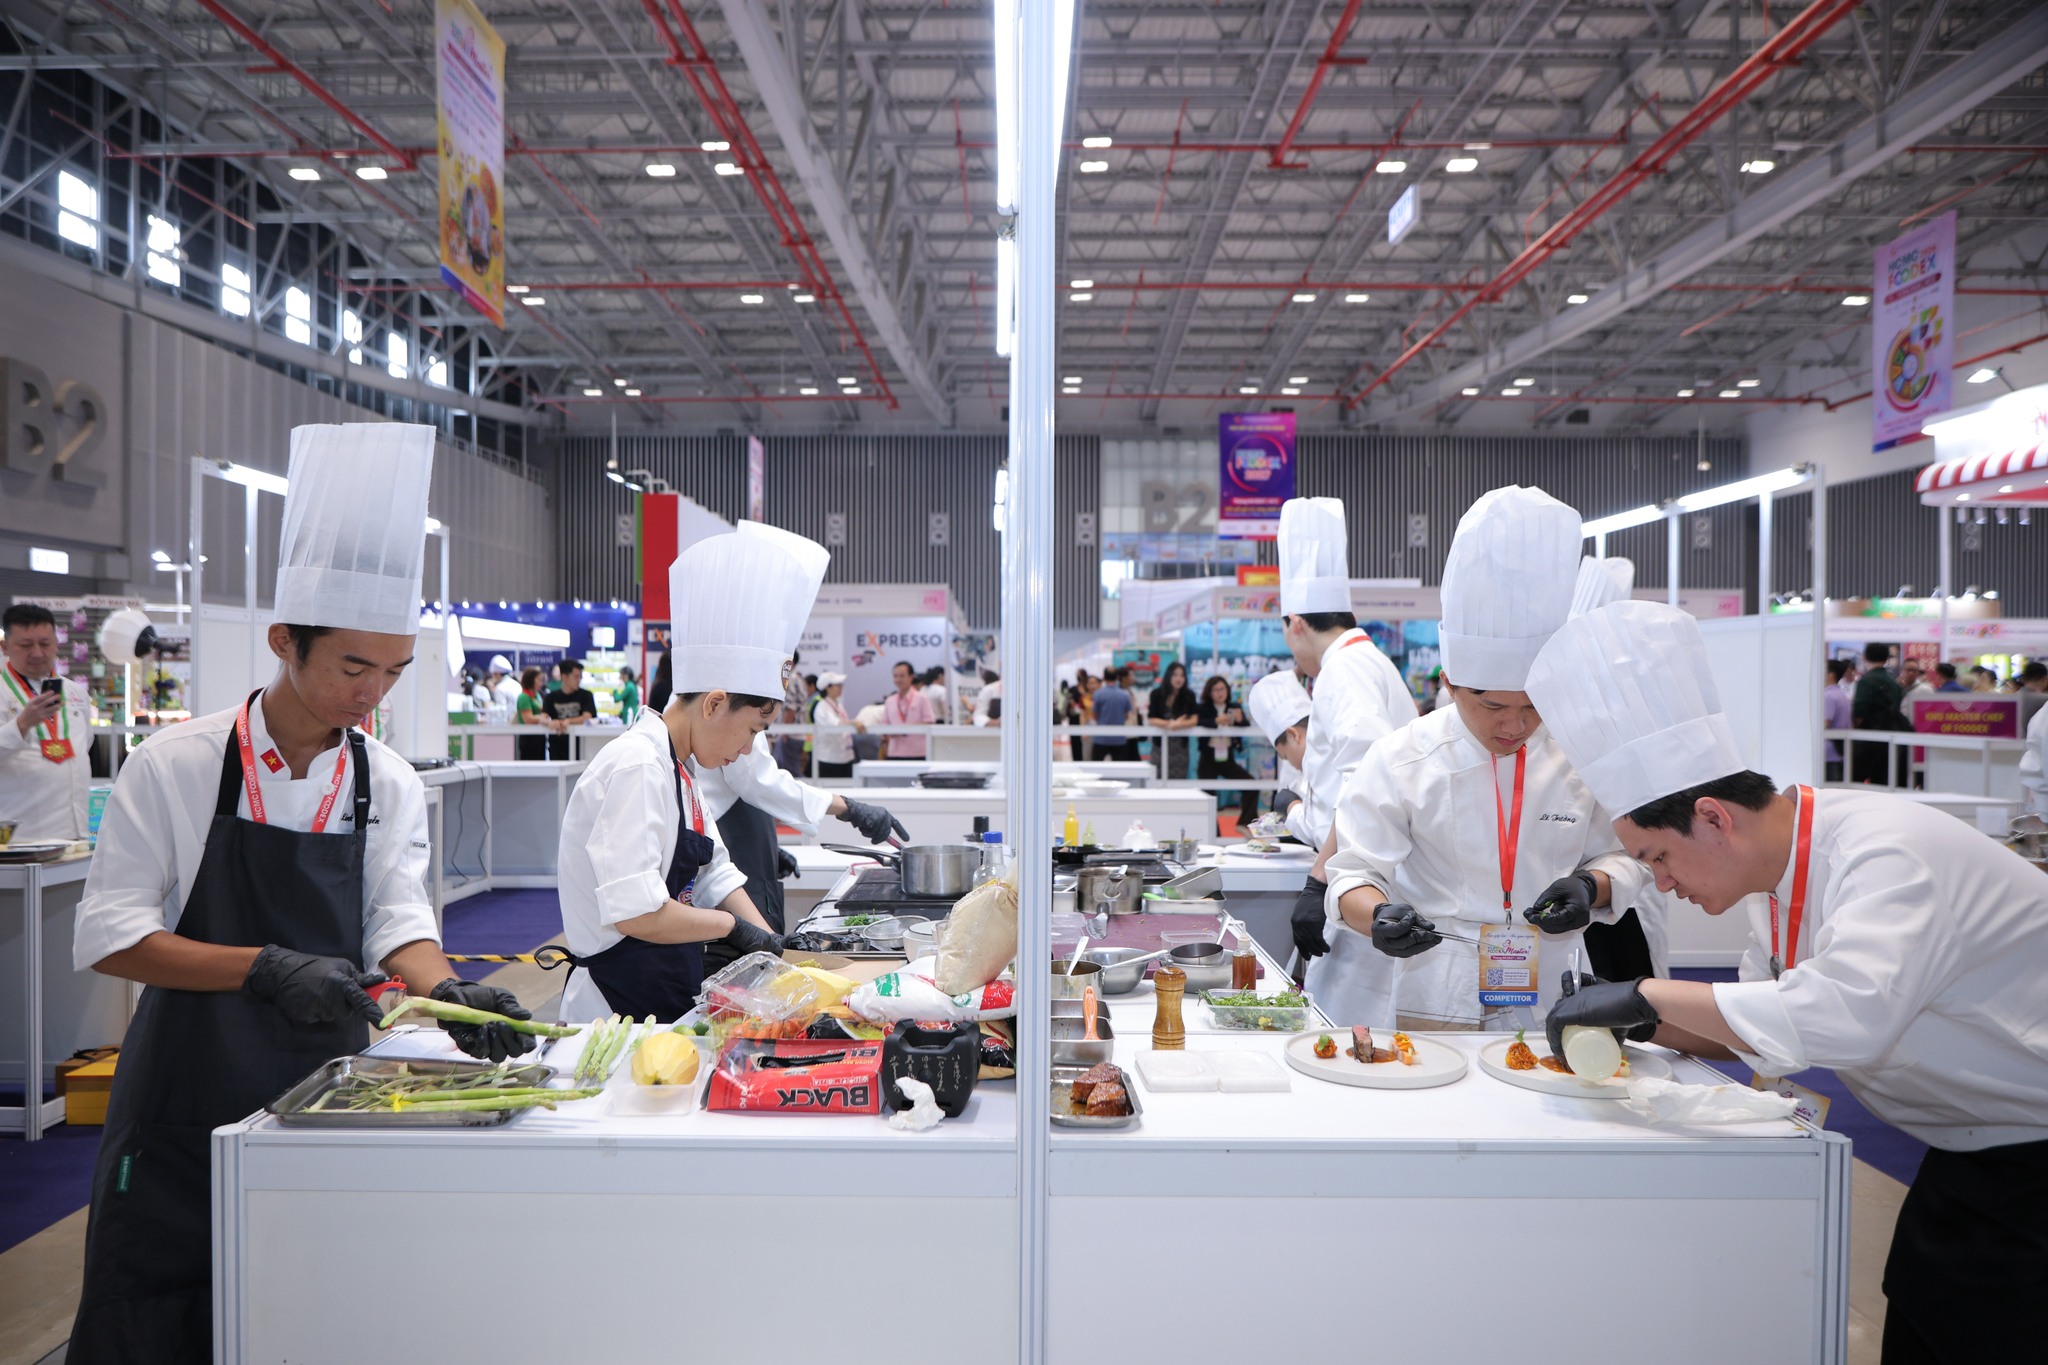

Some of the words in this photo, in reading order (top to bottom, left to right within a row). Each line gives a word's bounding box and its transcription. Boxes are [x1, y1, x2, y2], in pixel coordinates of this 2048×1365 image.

[1888, 253, 1936, 289] FOODEX
[0, 356, 108, 490] B2
[1142, 481, 1214, 533] B2
[856, 631, 942, 655] EXPRESSO
[247, 765, 259, 793] FOODEX
[252, 794, 263, 818] HCMC
[318, 796, 334, 823] FOODEX
[1505, 946, 1528, 955] Master
[1484, 994, 1532, 1002] COMPETITOR
[777, 1086, 869, 1107] BLACK
